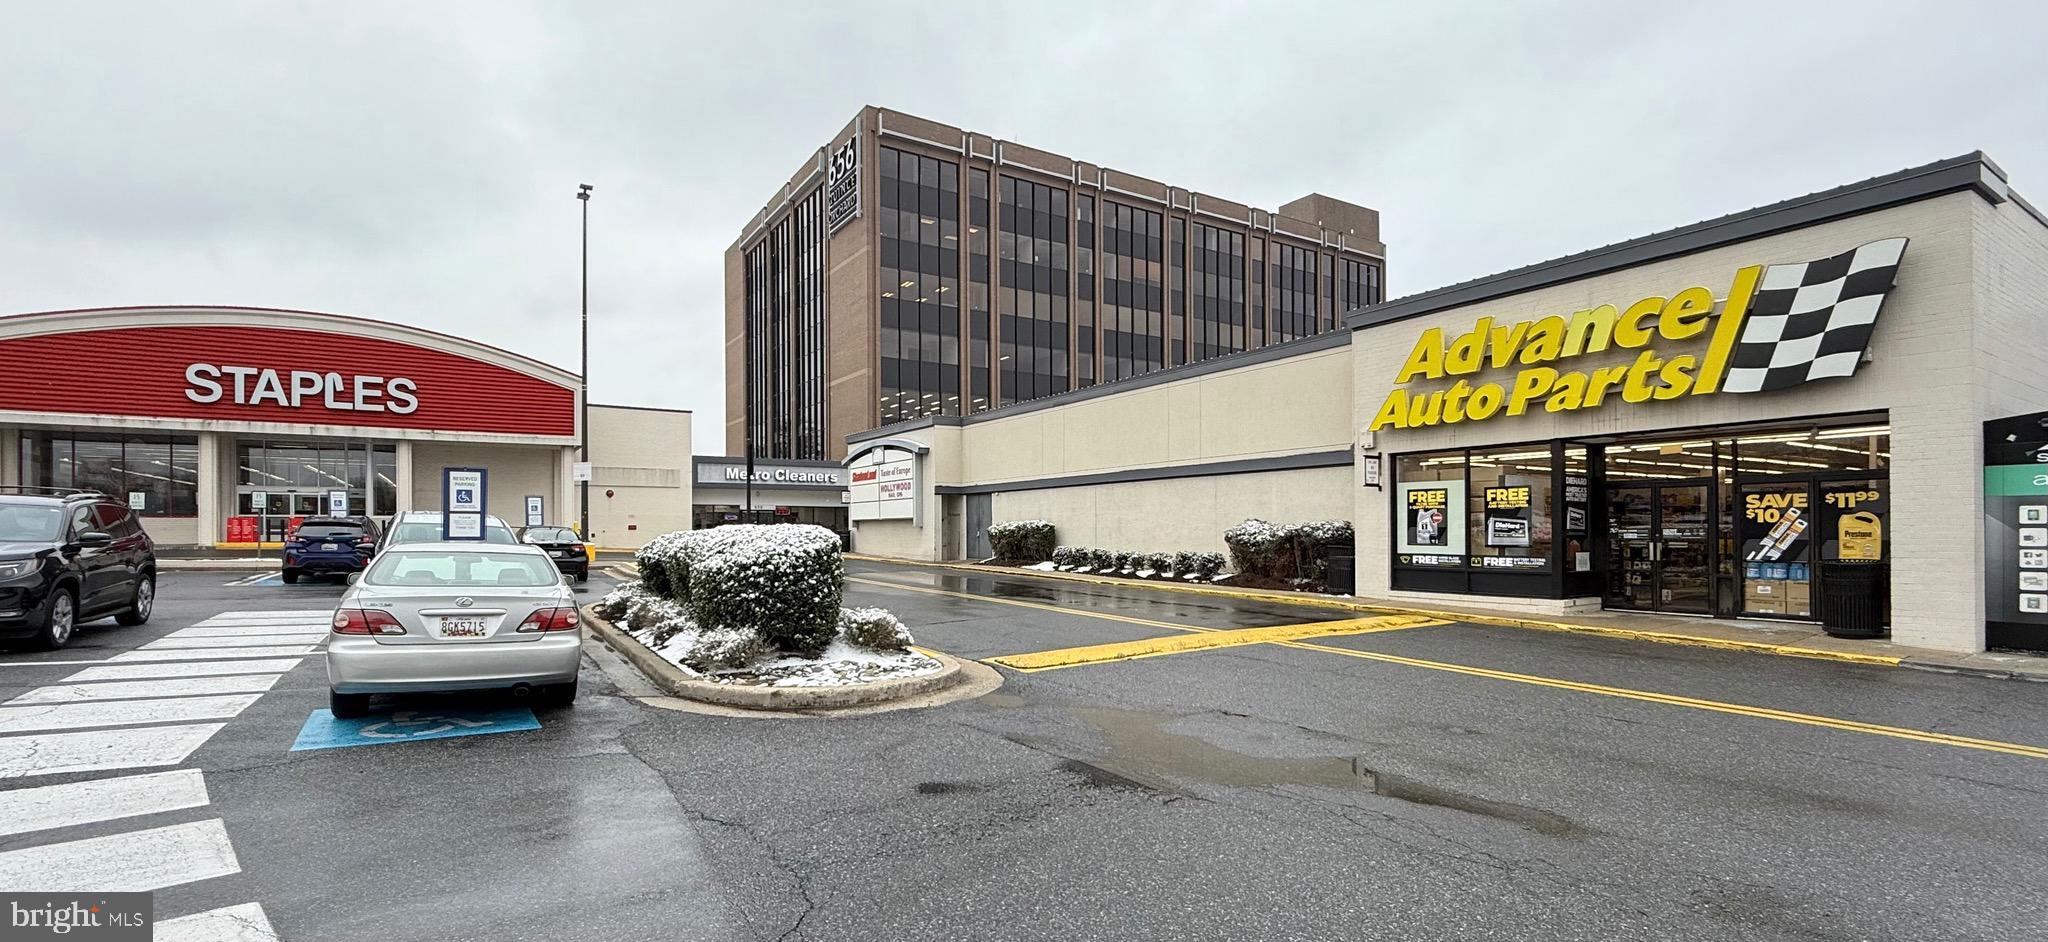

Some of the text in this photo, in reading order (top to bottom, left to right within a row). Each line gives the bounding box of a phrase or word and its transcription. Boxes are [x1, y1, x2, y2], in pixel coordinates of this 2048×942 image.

[828, 137, 854, 186] 656
[1395, 285, 1715, 385] Advance
[184, 362, 419, 415] STAPLES
[775, 469, 838, 483] Cleaners
[896, 467, 911, 476] Europe
[881, 482, 911, 492] HOLLYWOOD
[1409, 491, 1446, 503] FREE
[1487, 488, 1529, 501] FREE
[1745, 492, 1808, 509] SAVE
[1745, 508, 1780, 523] $10
[1495, 521, 1520, 529] DieHard
[1844, 530, 1873, 538] Prestone
[1412, 555, 1439, 564] FREE
[1483, 556, 1514, 567] FREE
[441, 621, 485, 633] 8GK5715
